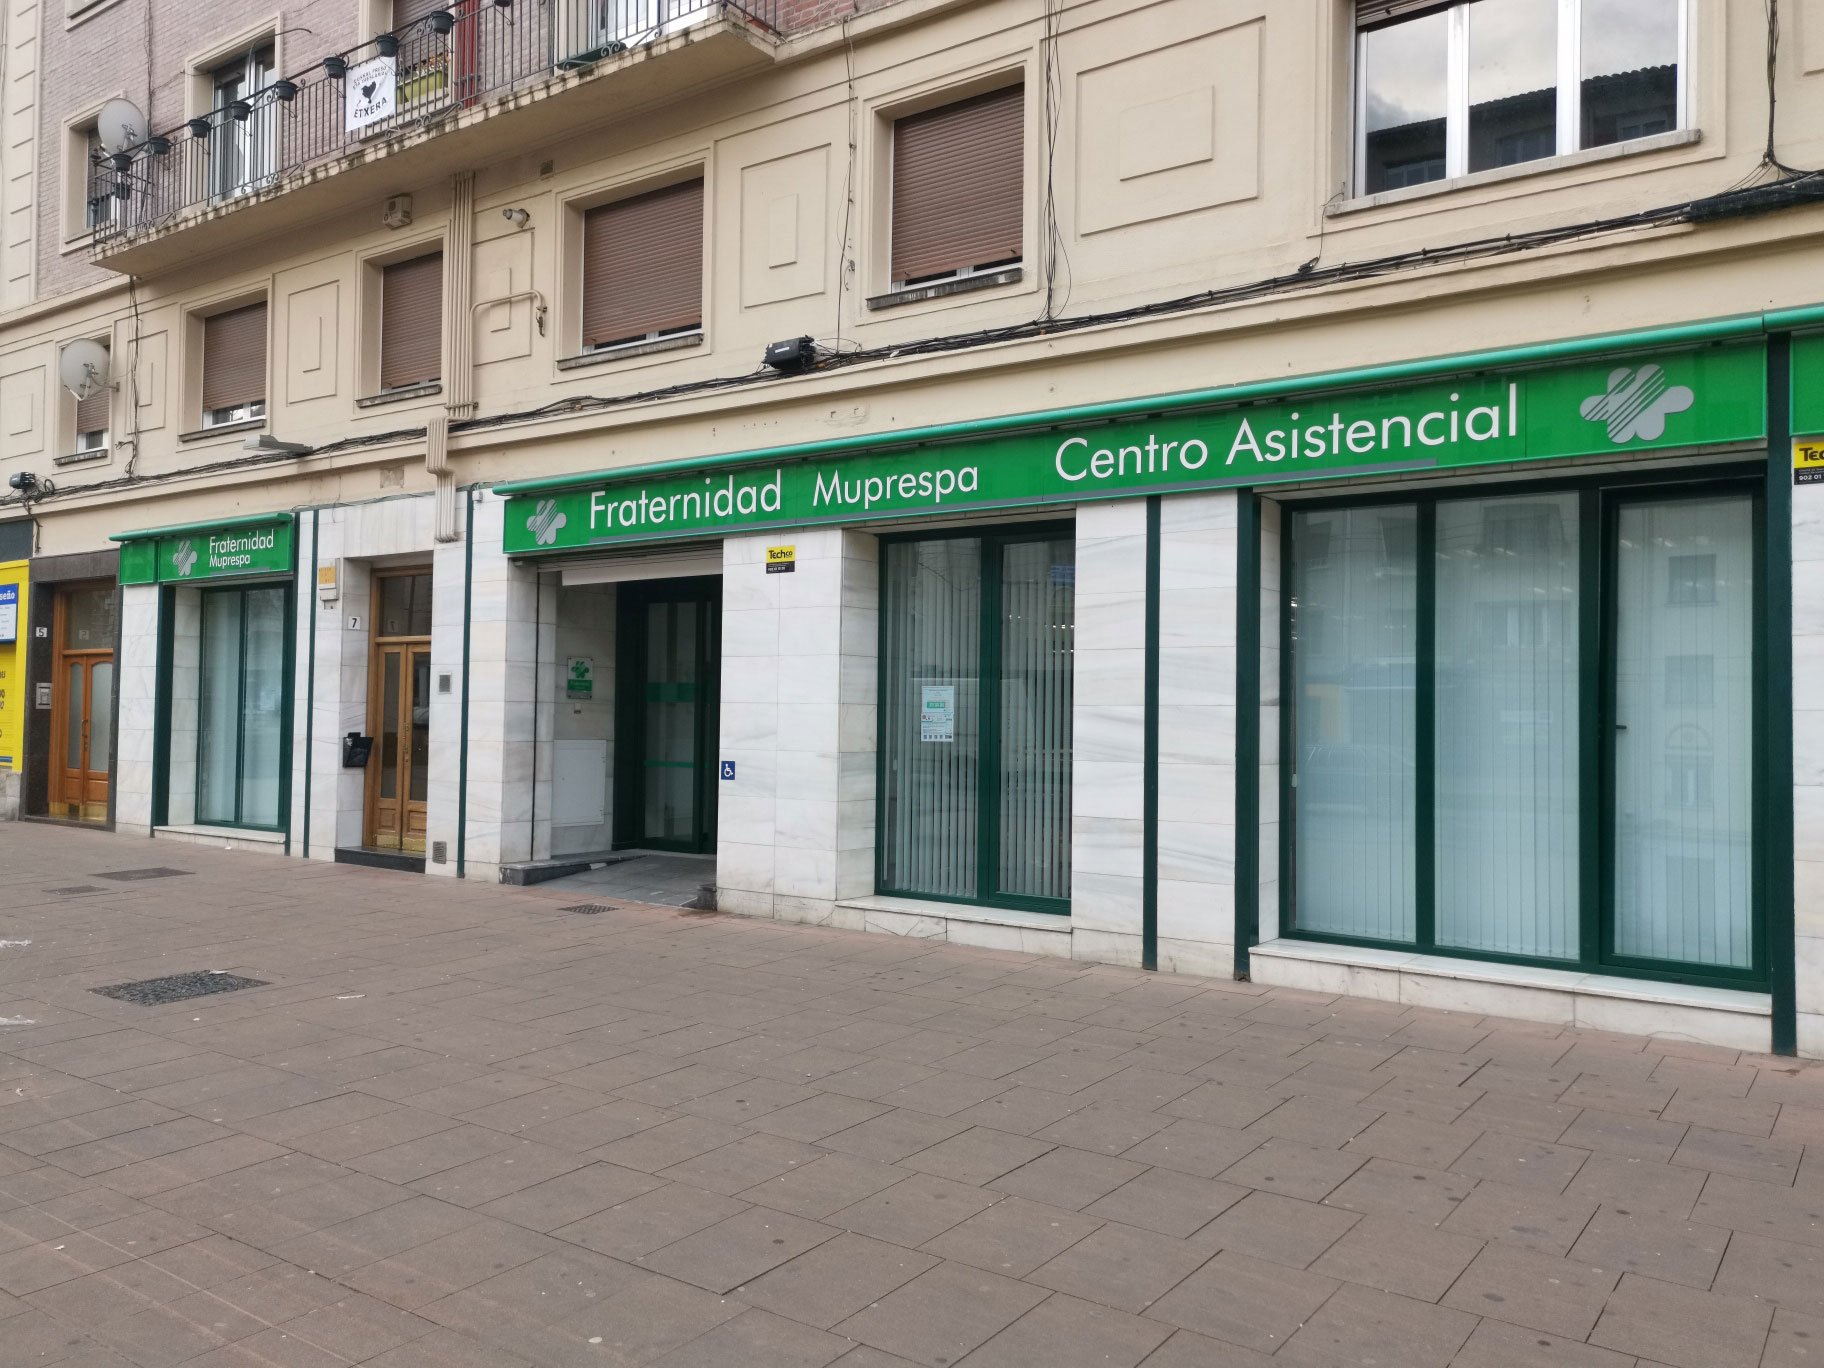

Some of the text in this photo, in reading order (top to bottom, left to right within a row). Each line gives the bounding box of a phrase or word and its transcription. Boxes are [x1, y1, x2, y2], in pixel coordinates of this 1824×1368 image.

[354, 97, 387, 118] ETXERA
[1055, 383, 1517, 482] Centro Asistencial
[590, 466, 979, 529] Fraternidad Muprespa
[209, 528, 274, 554] Fraternidad
[209, 554, 251, 569] Muprespa
[38, 628, 45, 637] 5
[352, 617, 358, 628] 7
